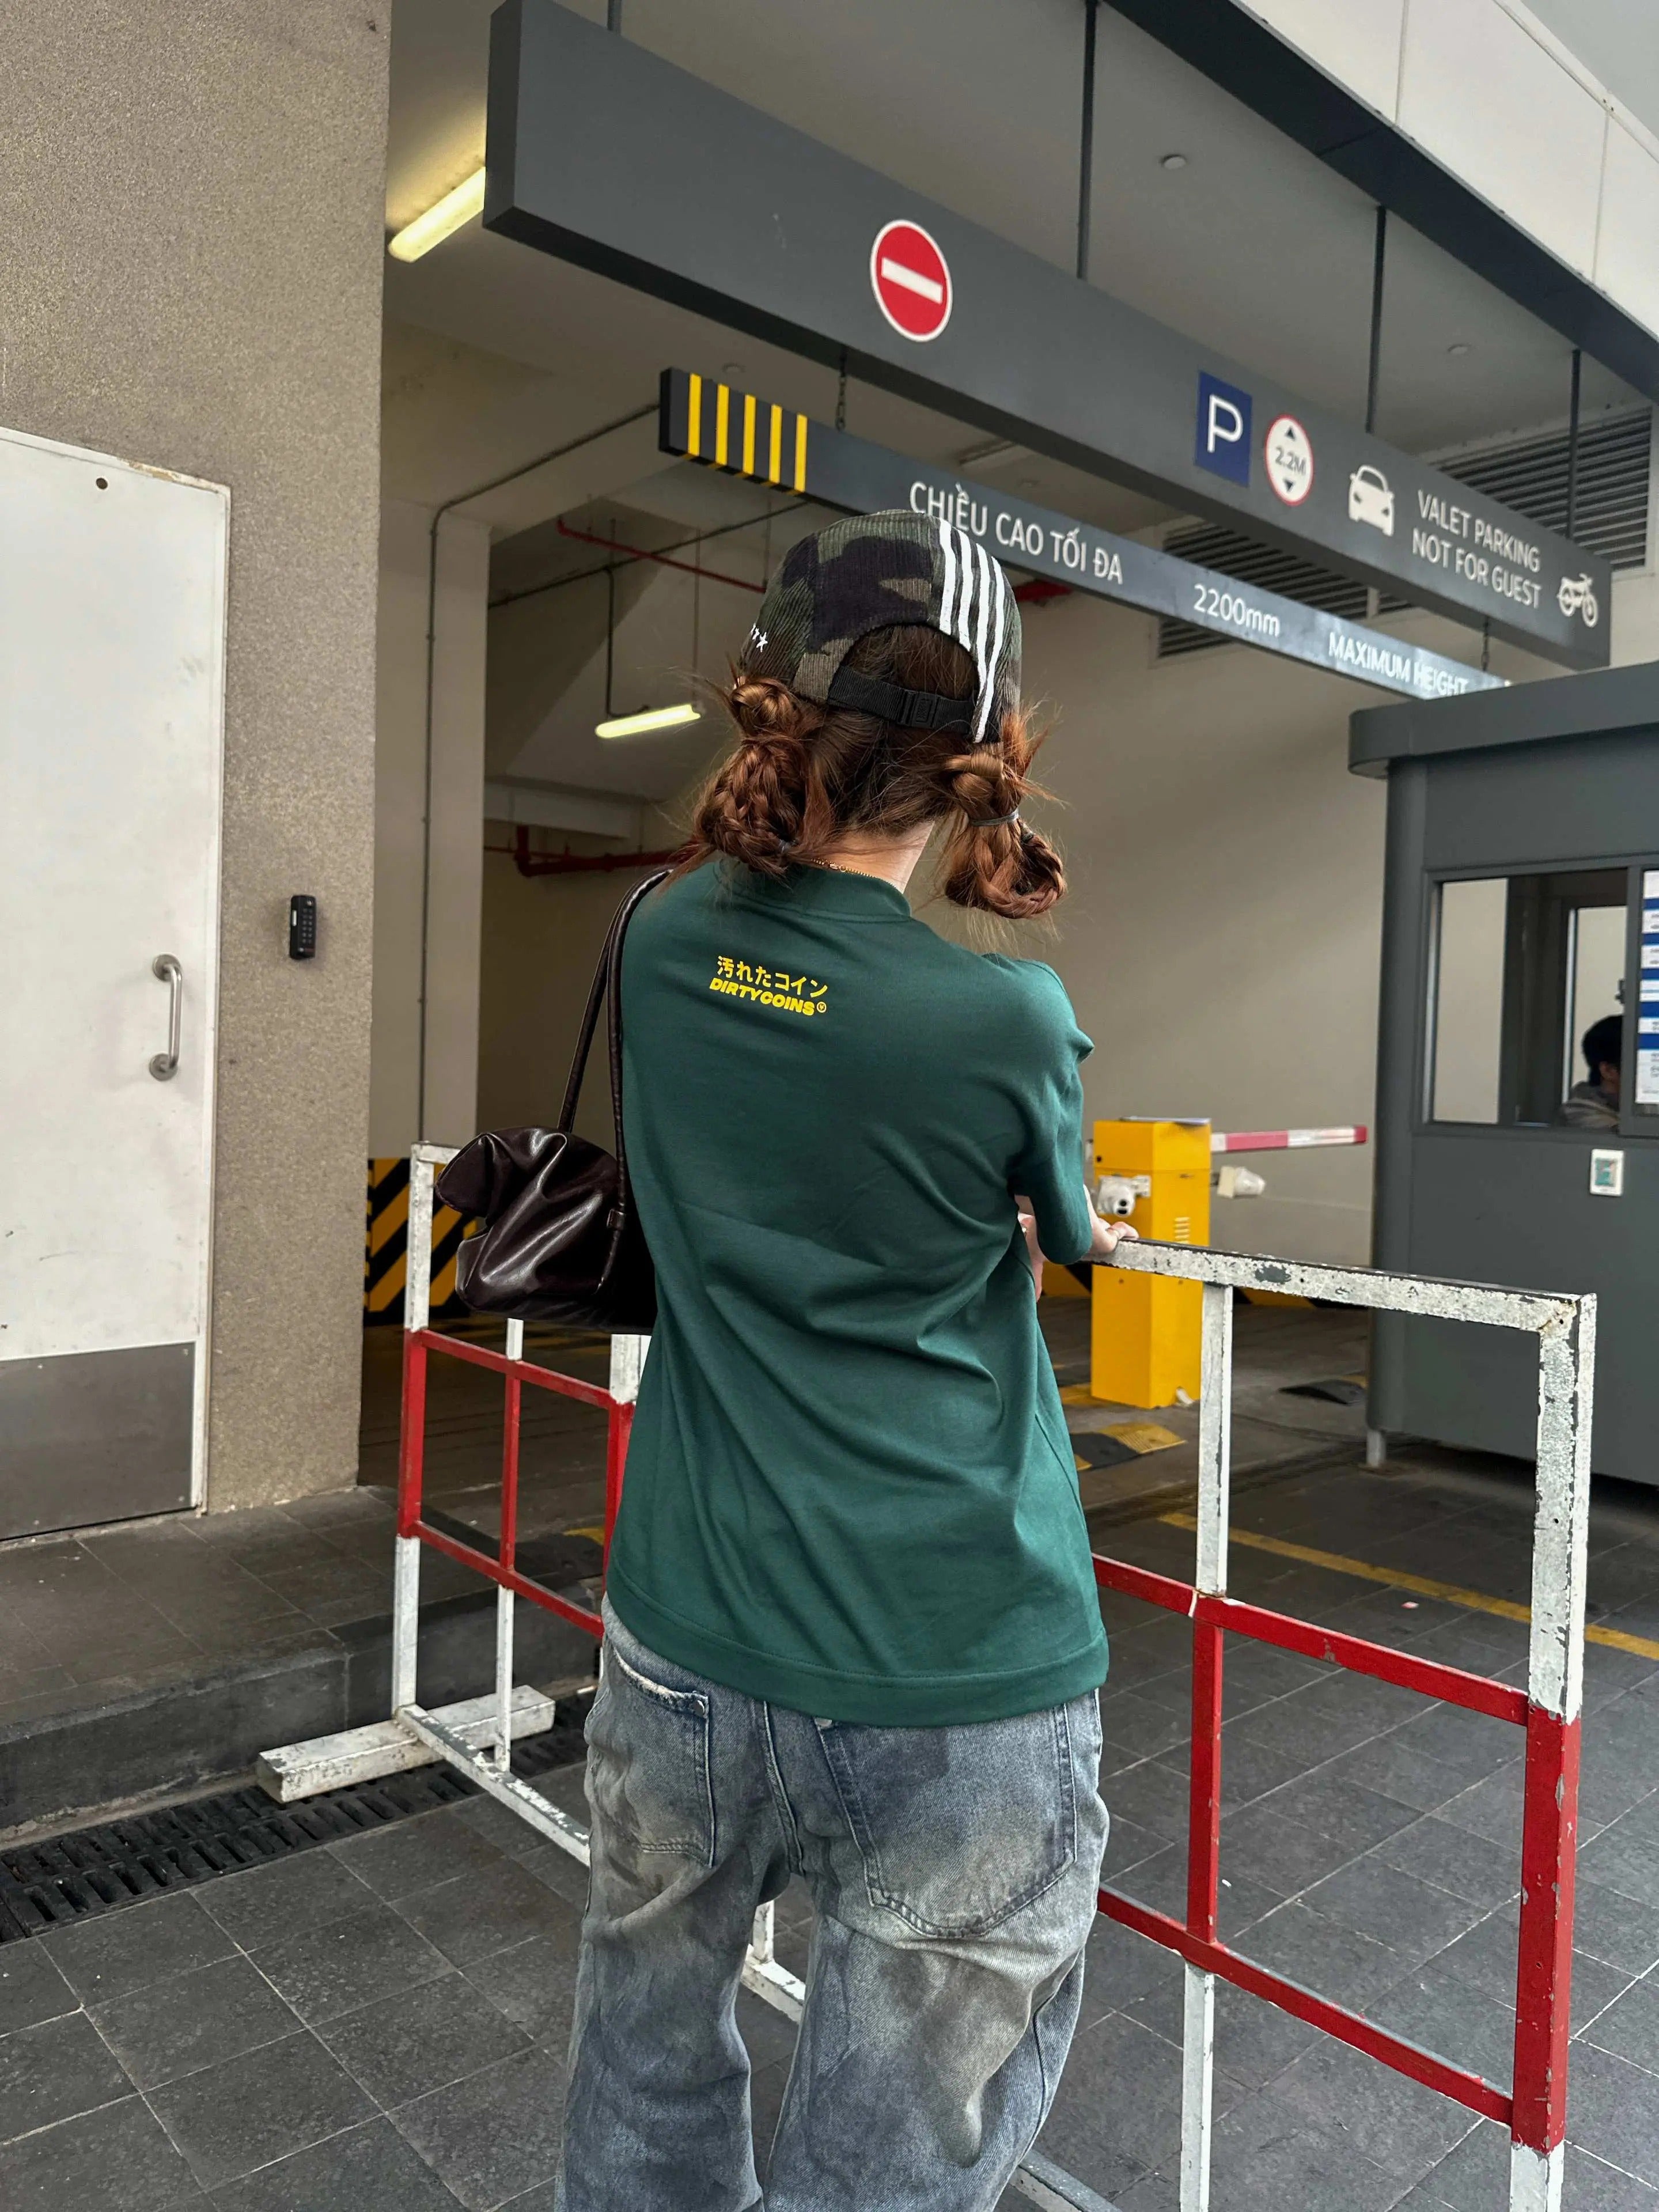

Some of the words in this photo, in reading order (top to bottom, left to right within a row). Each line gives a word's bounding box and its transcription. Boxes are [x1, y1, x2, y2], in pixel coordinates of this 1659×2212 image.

[1207, 394, 1243, 453] P
[1275, 445, 1306, 476] 2.2M
[1418, 490, 1471, 539] VALET
[1475, 518, 1540, 573] PARKING
[910, 482, 987, 536] CHIỀU
[996, 512, 1044, 555] CAO
[1050, 527, 1087, 571] TỐI
[1093, 547, 1123, 585] ĐA
[1194, 584, 1281, 638] 2200mm
[1329, 632, 1411, 683] MAXIMUM
[1414, 662, 1469, 696] HEIGHT
[1412, 528, 1453, 568] NOT
[1455, 548, 1489, 586] FOR
[1492, 565, 1542, 609] GUEST
[717, 955, 828, 998] 汚れたコイン
